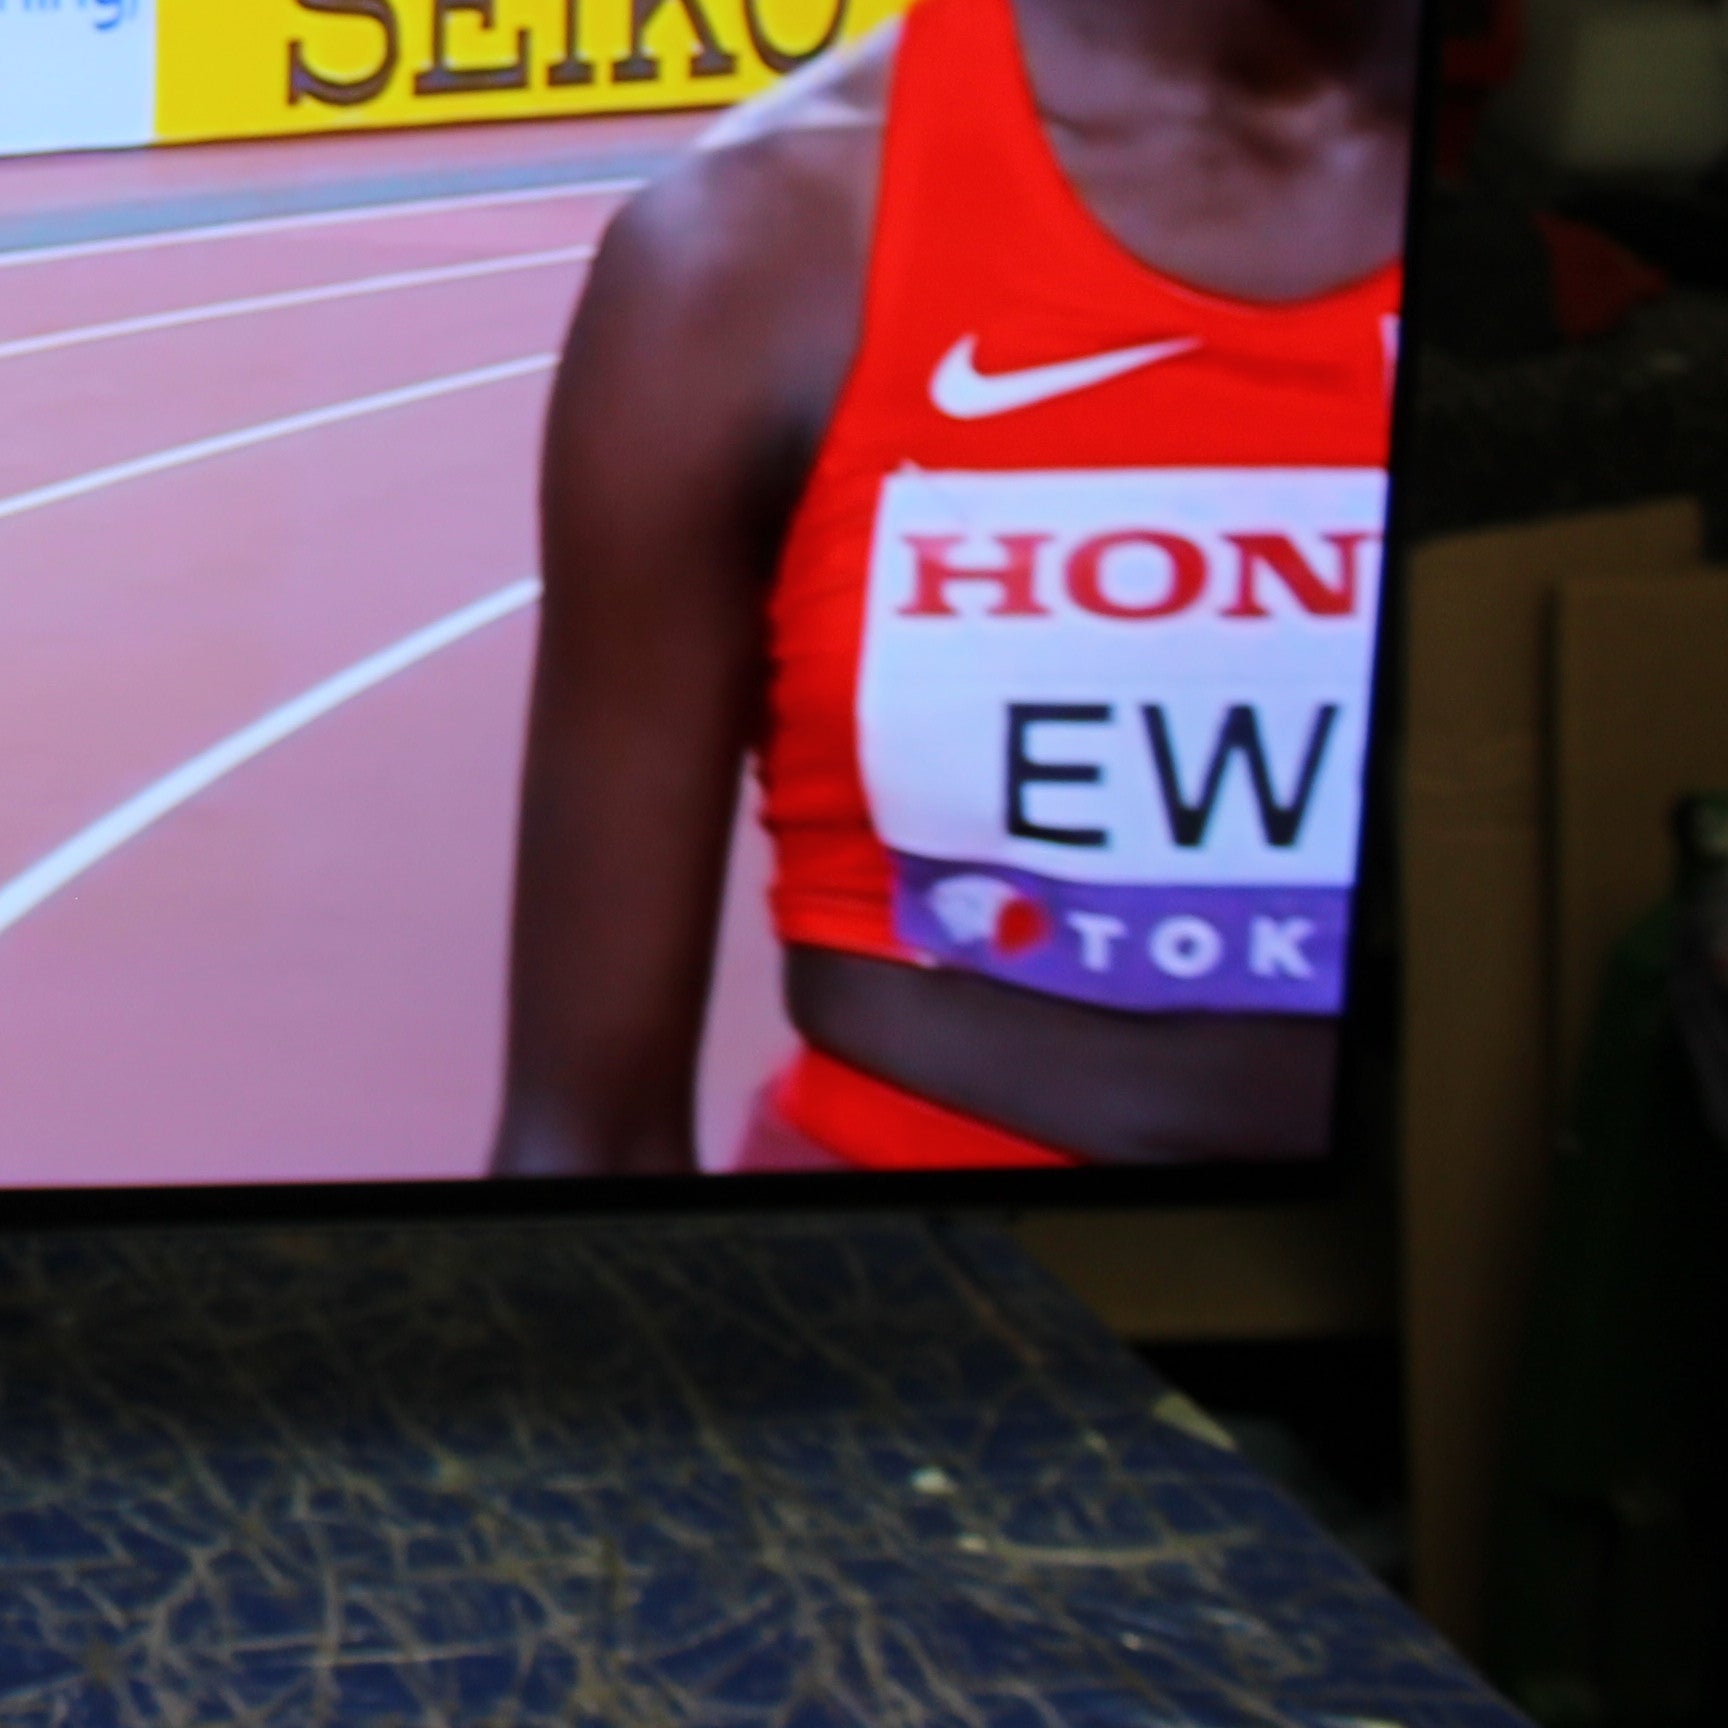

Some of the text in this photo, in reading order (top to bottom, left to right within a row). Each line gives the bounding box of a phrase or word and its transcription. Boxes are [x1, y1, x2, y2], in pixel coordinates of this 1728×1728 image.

[894, 528, 1384, 621] HON
[1005, 703, 1340, 848] EW
[1064, 910, 1315, 980] TOK
